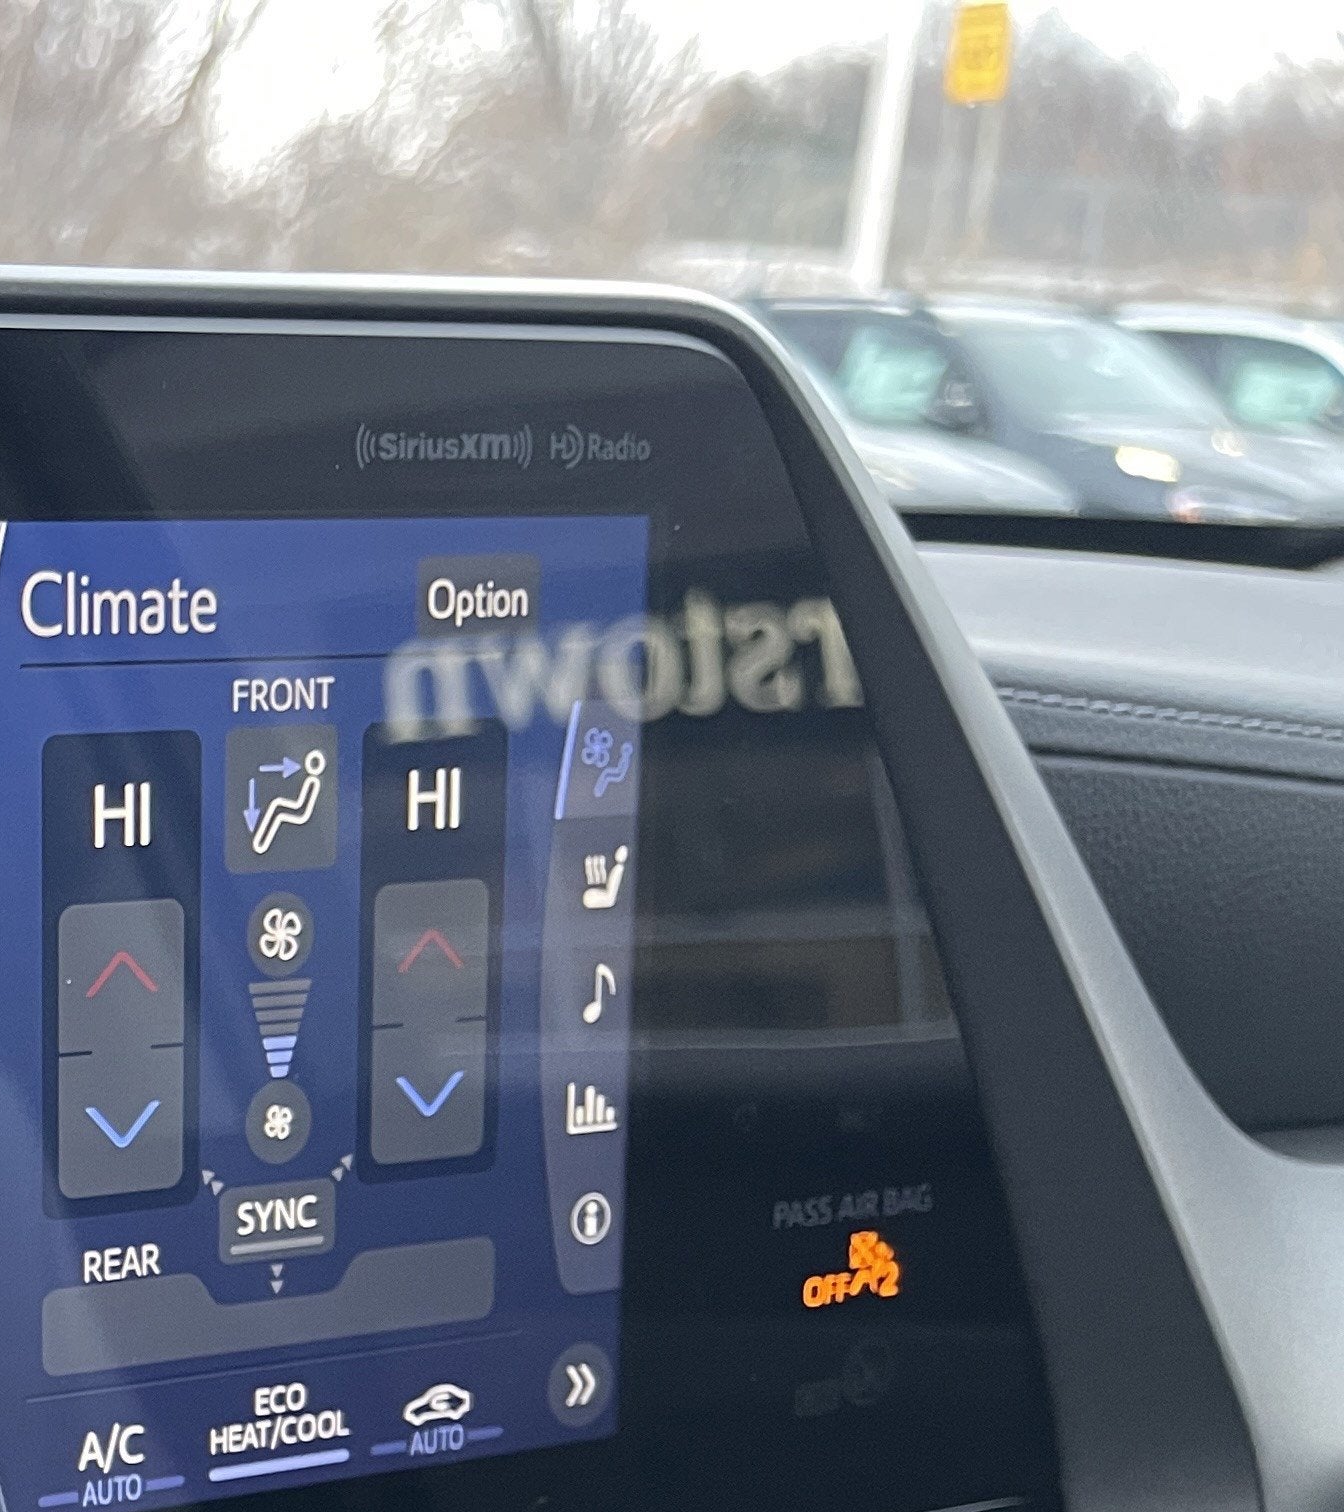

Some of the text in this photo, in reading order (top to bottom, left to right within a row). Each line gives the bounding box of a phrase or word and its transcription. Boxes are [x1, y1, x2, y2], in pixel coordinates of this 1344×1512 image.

[587, 431, 651, 461] Radio
[20, 570, 218, 638] Climate
[426, 577, 529, 628] Option
[232, 675, 336, 714] FRONT
[92, 781, 152, 850] HI
[406, 767, 462, 833] HI
[236, 1194, 318, 1236] SYNC
[83, 1243, 161, 1284] REAR
[803, 1272, 850, 1308] OFF
[254, 1382, 307, 1417] ECO
[78, 1422, 146, 1474] A/C
[209, 1409, 351, 1456] HEAT/COOL
[410, 1423, 465, 1456] AUTO
[82, 1473, 142, 1508] AUTO
